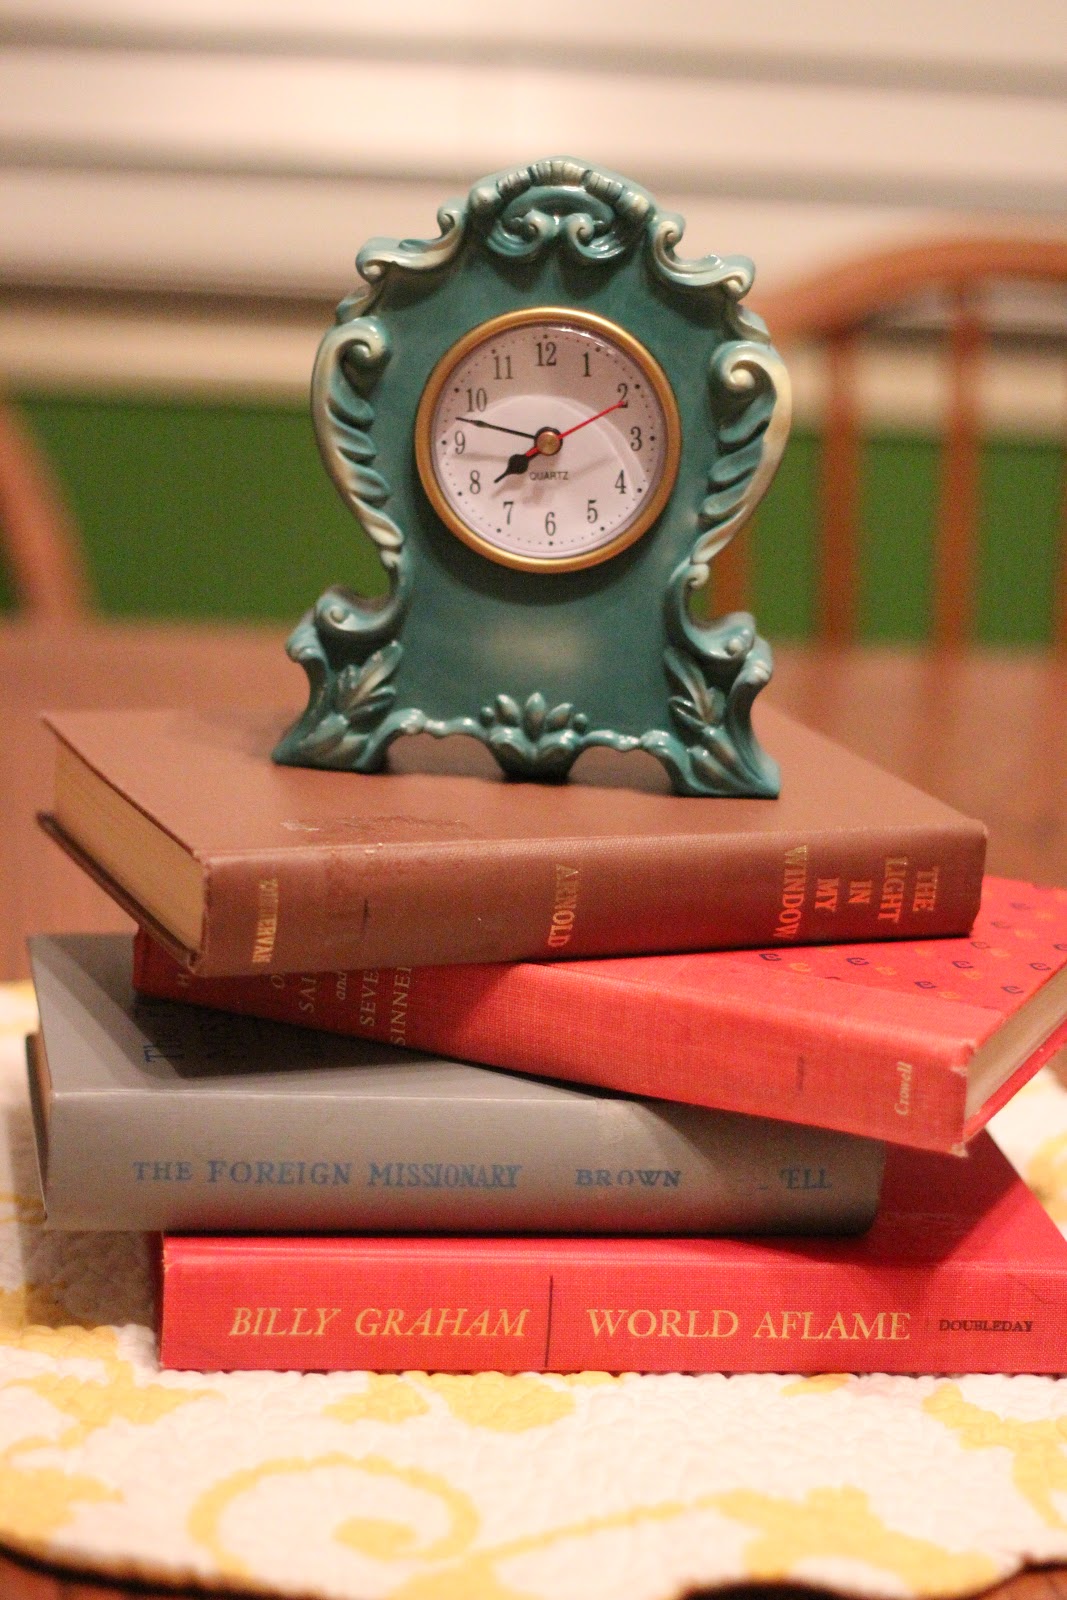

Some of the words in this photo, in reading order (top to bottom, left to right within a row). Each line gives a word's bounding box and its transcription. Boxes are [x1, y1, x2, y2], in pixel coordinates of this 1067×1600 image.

[535, 341, 557, 367] 12
[582, 352, 592, 377] 1
[493, 355, 514, 380] 11
[466, 387, 488, 412] 10
[616, 383, 629, 409] 2
[454, 431, 466, 454] 9
[630, 426, 642, 451] 3
[469, 470, 481, 494] 8
[529, 471, 569, 481] QUARTZ
[614, 469, 627, 494] 4
[503, 501, 514, 525] 7
[544, 511, 556, 536] 6
[586, 500, 599, 523] 5
[773, 844, 807, 940] WINDOW
[814, 878, 839, 912] MY
[848, 880, 872, 903] IN
[877, 856, 908, 923] LIGHT
[912, 865, 939, 912] THE
[547, 863, 579, 948] ARNOLD
[252, 878, 278, 964] ZOERVAN
[894, 1061, 913, 1116] Crowell
[133, 1160, 194, 1182] THE
[206, 1160, 352, 1187] FOREIGN
[367, 1163, 522, 1189] MISSIONARY
[575, 1168, 682, 1188] BROWN
[228, 1307, 341, 1337] BILLY
[355, 1307, 531, 1337] GRAHAM
[586, 1308, 739, 1338] WORLD
[753, 1310, 911, 1341] AFLAME
[939, 1318, 1034, 1333] DOUBLEDAY
